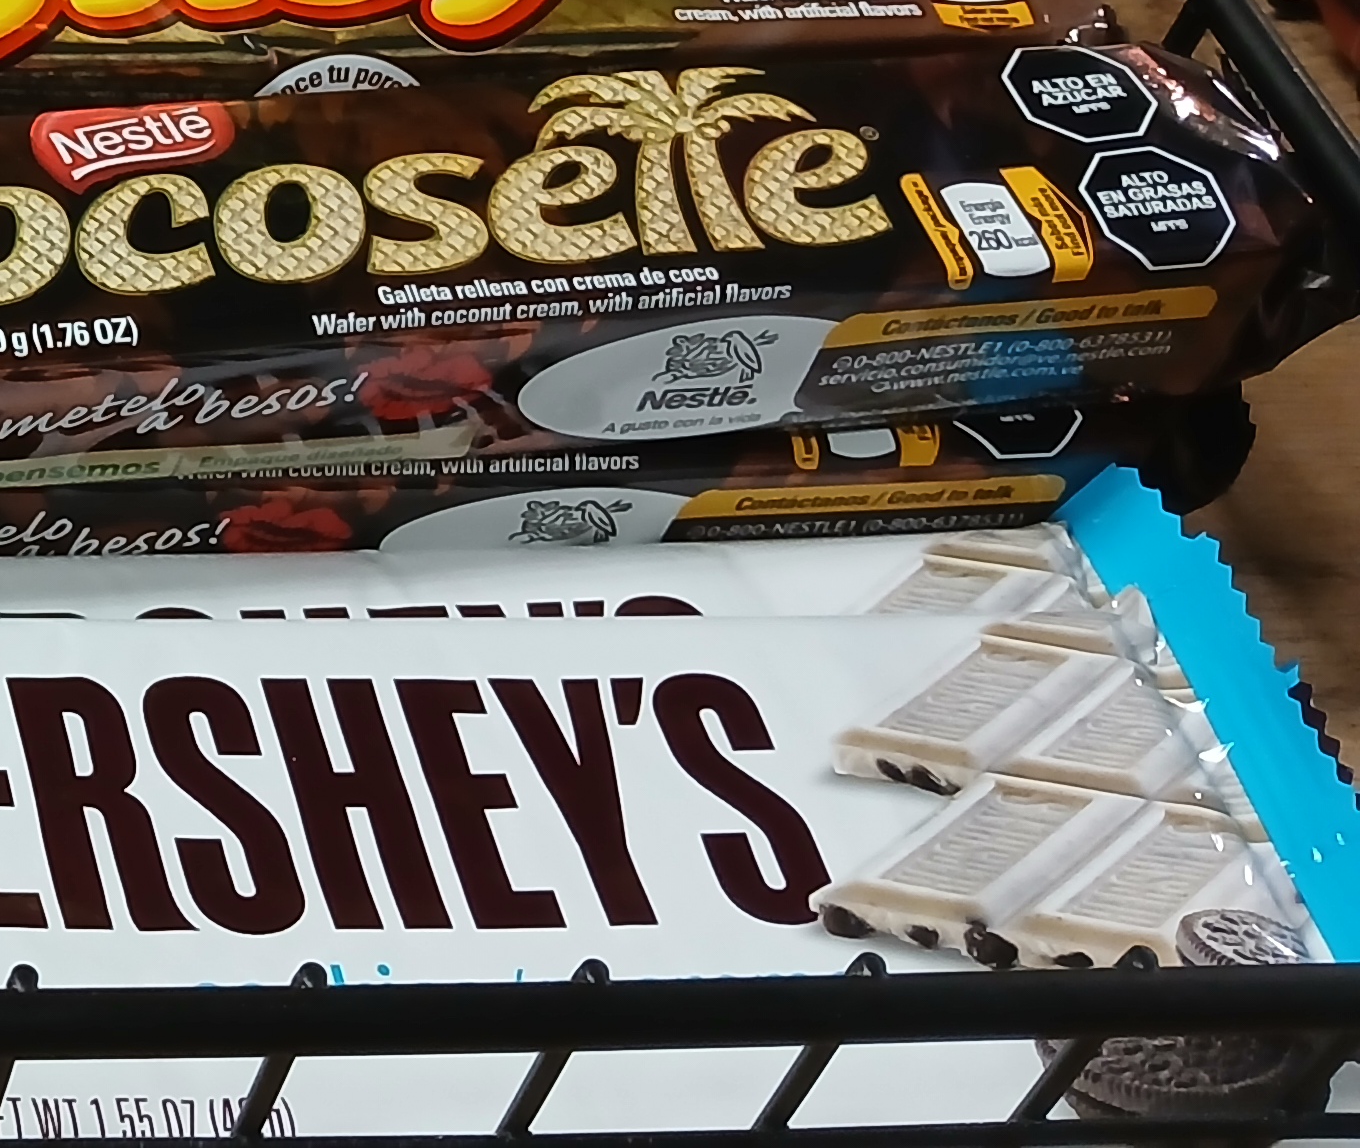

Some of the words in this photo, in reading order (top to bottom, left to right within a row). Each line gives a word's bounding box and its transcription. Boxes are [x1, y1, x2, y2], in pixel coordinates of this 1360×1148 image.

[737, 5, 783, 21] with
[327, 64, 350, 83] tu
[1031, 76, 1084, 94] ALTO
[1085, 73, 1117, 88] EN
[1121, 170, 1169, 188] ALTO
[1096, 190, 1124, 205] EN
[1127, 181, 1207, 201] GRASAS
[1105, 196, 1217, 219] SATURADAS
[968, 228, 1012, 251] 260
[378, 285, 453, 305] Galleta
[456, 279, 529, 301] rellena
[531, 277, 569, 295] con
[573, 269, 635, 291] crema
[639, 266, 666, 286] de
[669, 265, 720, 284] coco
[312, 312, 377, 337] Wafer
[379, 308, 427, 330] with
[430, 302, 513, 327] coconut
[517, 296, 585, 322] cream,
[589, 292, 634, 315] with
[637, 285, 722, 310] artificial
[726, 282, 792, 304] flavors
[881, 314, 1019, 337] Contáctanos
[1036, 307, 1096, 325] Good
[1097, 304, 1120, 320] to
[1121, 300, 1164, 317] talk
[12, 331, 29, 359] g
[32, 319, 90, 353] (1.76
[93, 317, 140, 349] OZ)
[194, 373, 369, 426] besos!
[370, 457, 438, 479] cream,
[441, 455, 485, 475] with
